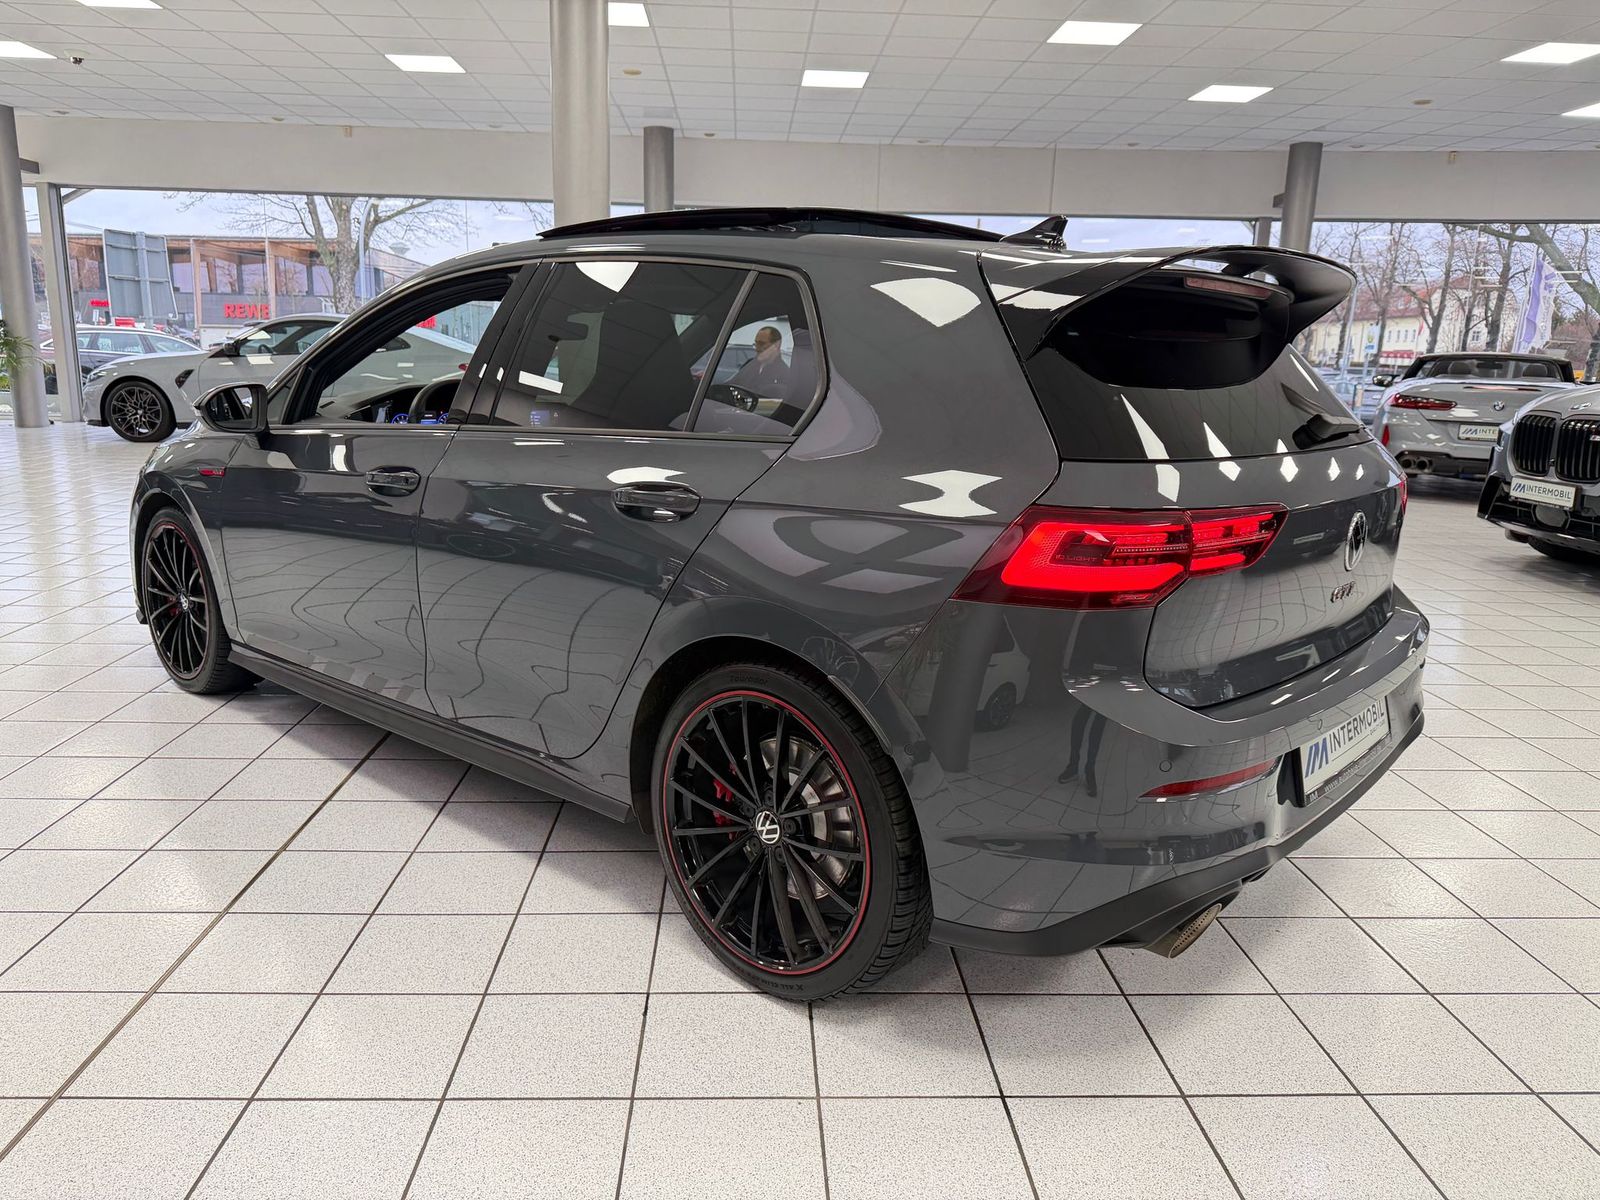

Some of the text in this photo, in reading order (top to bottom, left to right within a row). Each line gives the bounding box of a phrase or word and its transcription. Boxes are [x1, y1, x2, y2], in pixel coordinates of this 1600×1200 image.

[223, 303, 270, 319] REWE
[1526, 485, 1572, 499] INTERMOBIL
[1329, 700, 1385, 753] INTERMOBIL
